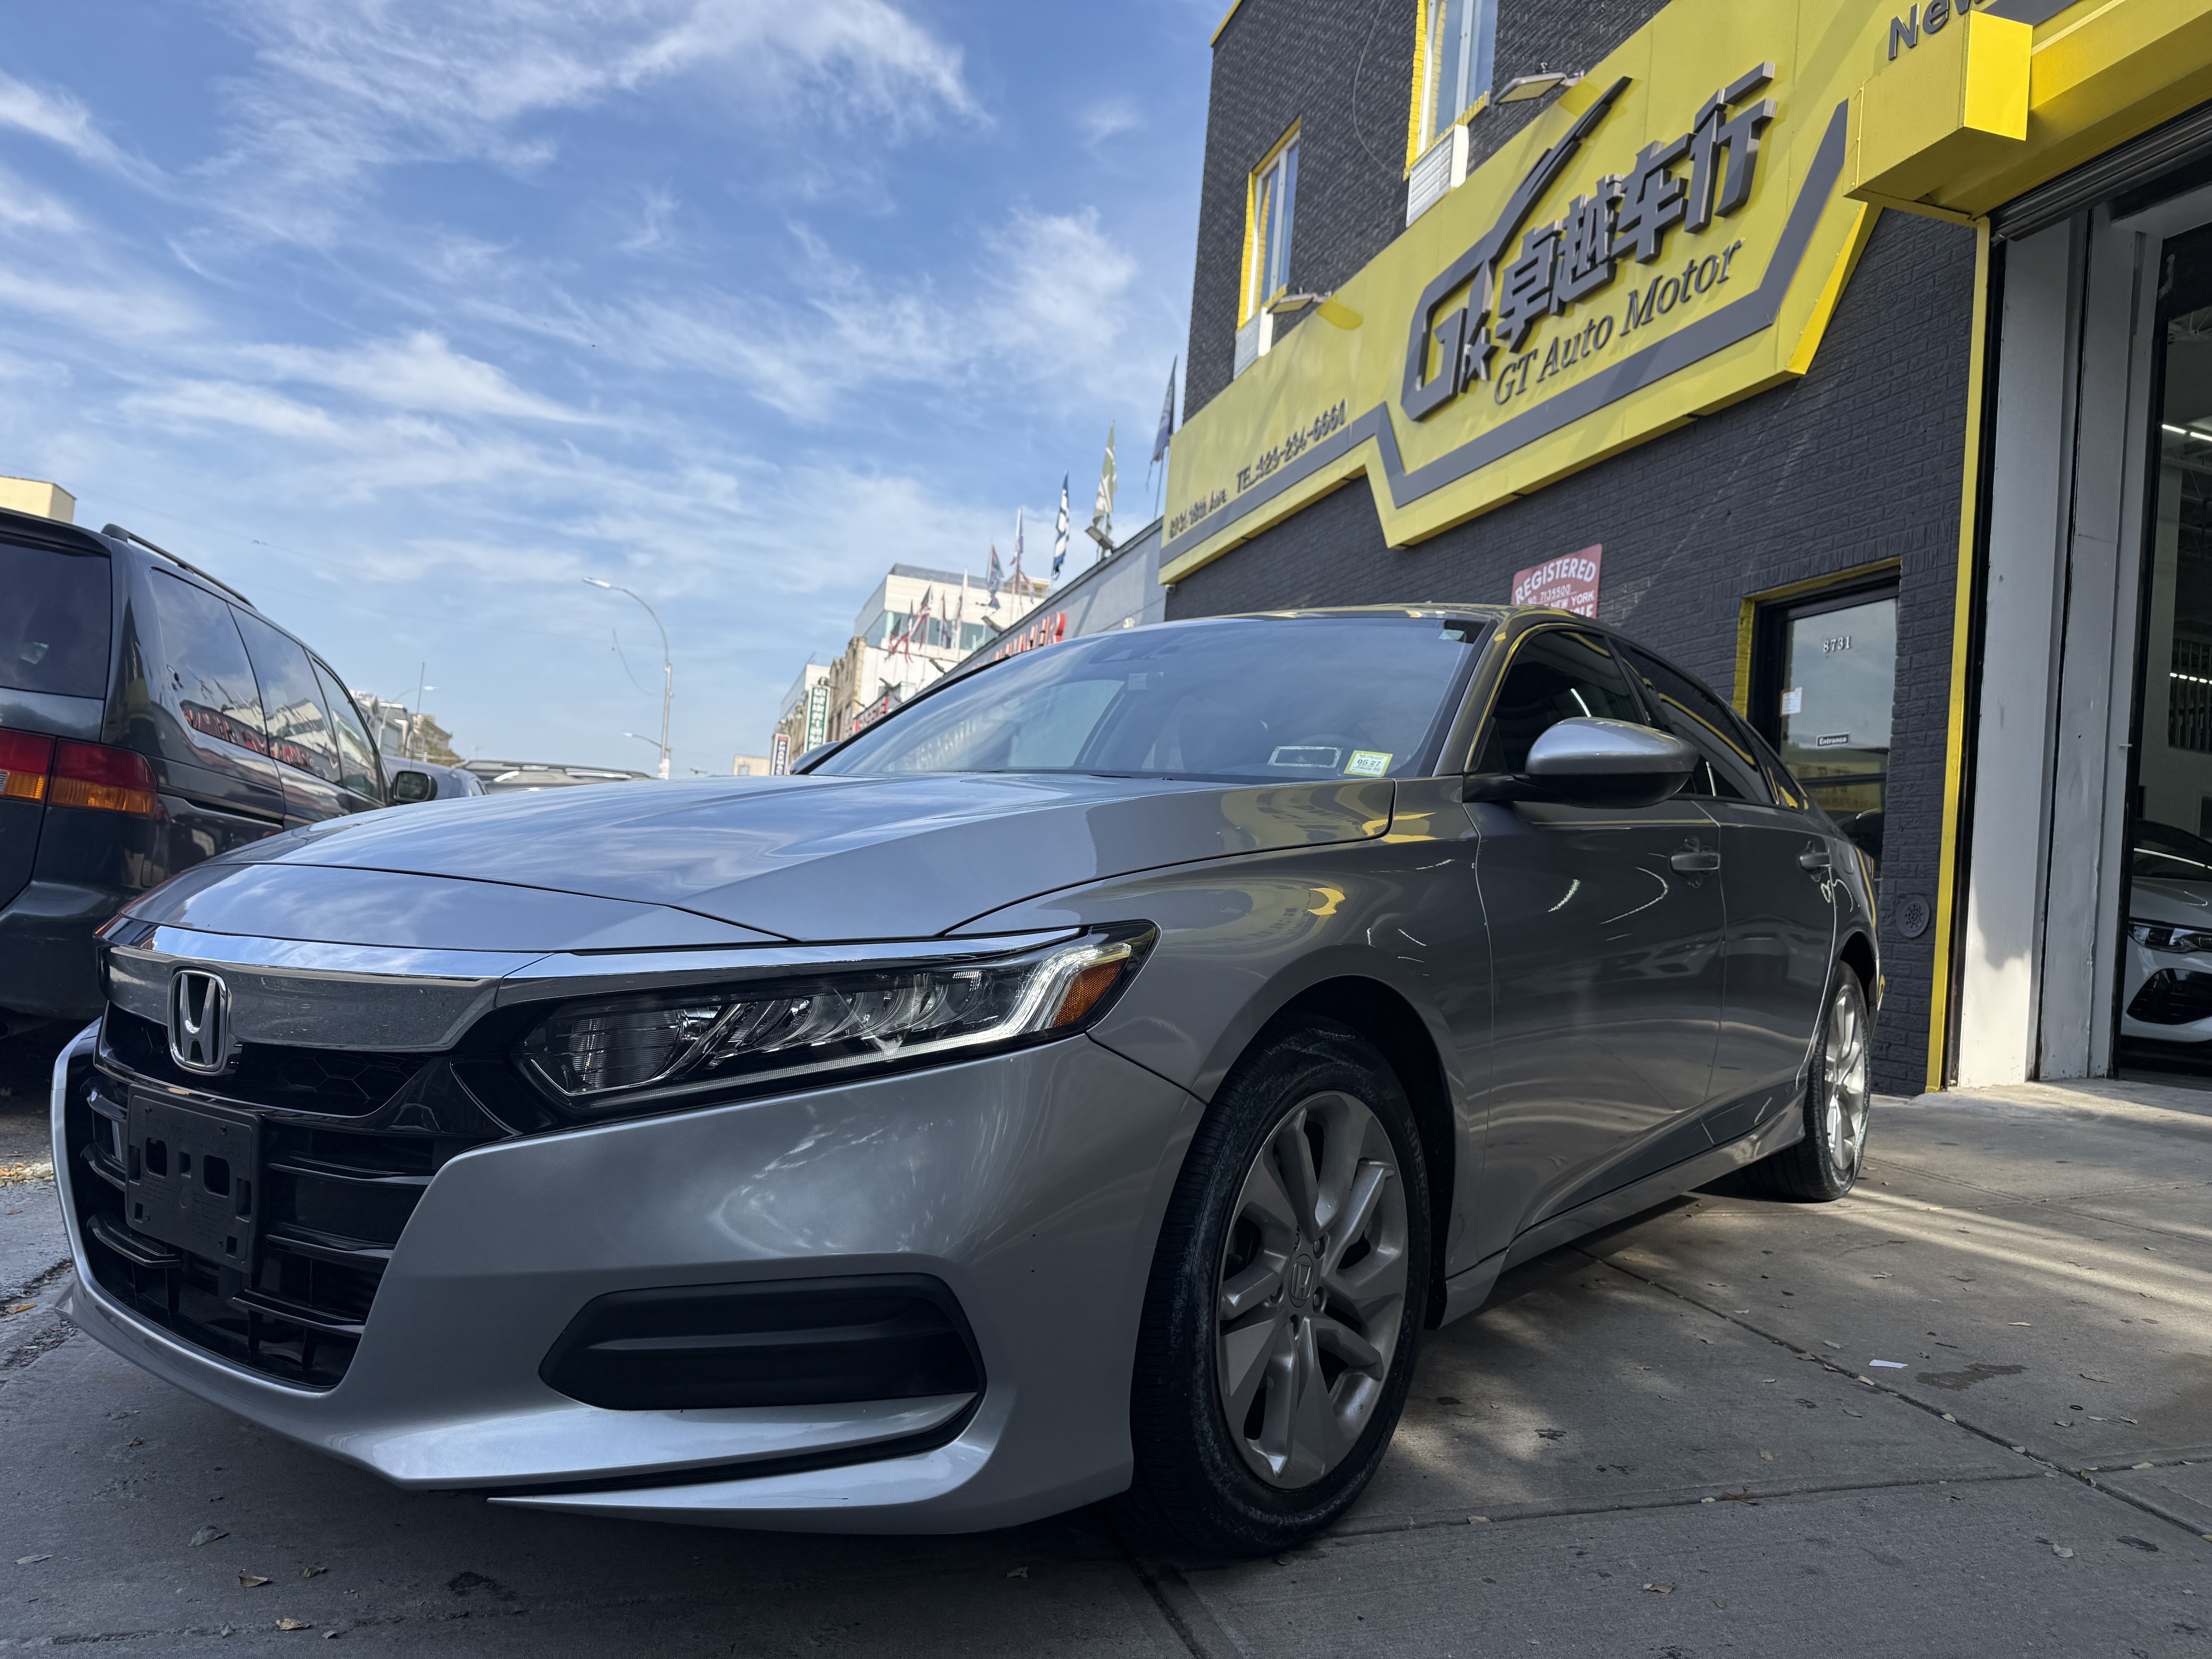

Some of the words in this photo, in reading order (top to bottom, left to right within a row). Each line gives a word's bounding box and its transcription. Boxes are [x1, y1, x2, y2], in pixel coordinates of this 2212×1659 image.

[1888, 0, 1984, 60] Ne
[1495, 62, 1777, 352] 卓越车行
[1495, 349, 1537, 405] GT
[1536, 316, 1613, 383] Auto
[1620, 238, 1743, 337] Motor
[1515, 558, 1597, 605] REGISTERED
[1571, 589, 1595, 606] YORK
[1823, 635, 1851, 653] 8731
[1819, 737, 1847, 745] Entrance
